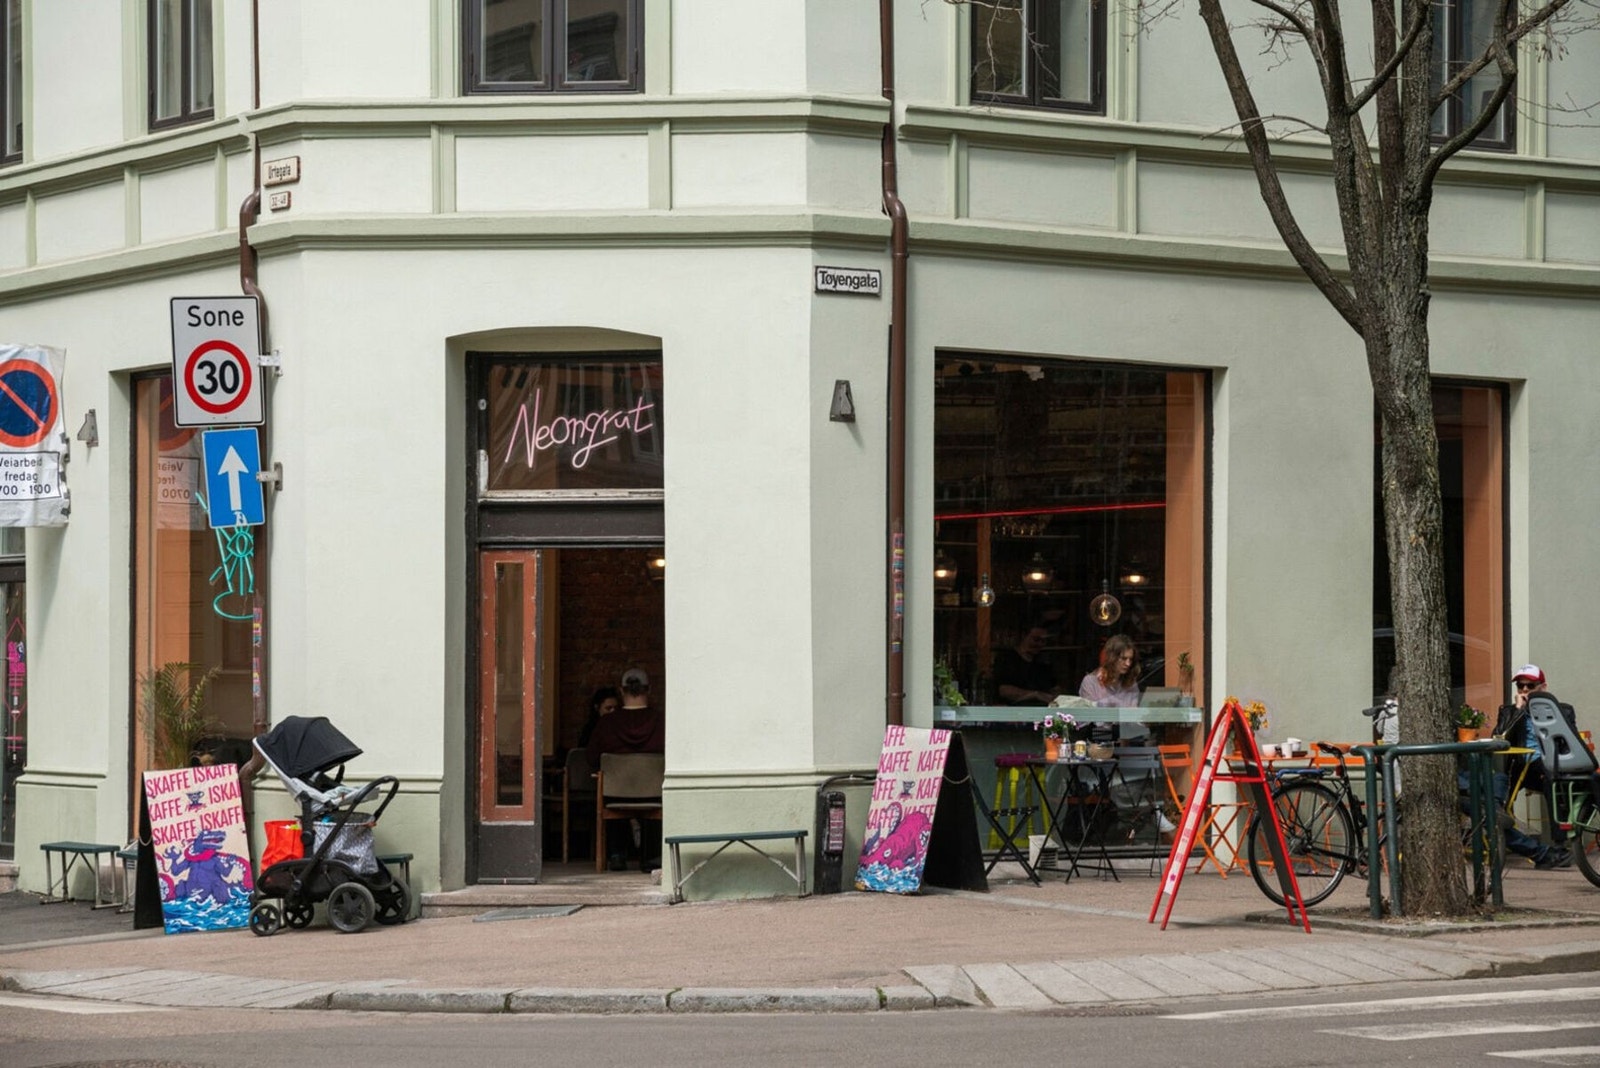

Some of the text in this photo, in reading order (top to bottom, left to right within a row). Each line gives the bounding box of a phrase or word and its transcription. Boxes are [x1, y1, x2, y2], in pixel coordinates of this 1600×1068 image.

[819, 270, 878, 289] Tøyengata
[187, 305, 244, 327] Sone
[197, 360, 240, 395] 30
[505, 388, 654, 468] Neongrut
[5, 471, 38, 483] fredag
